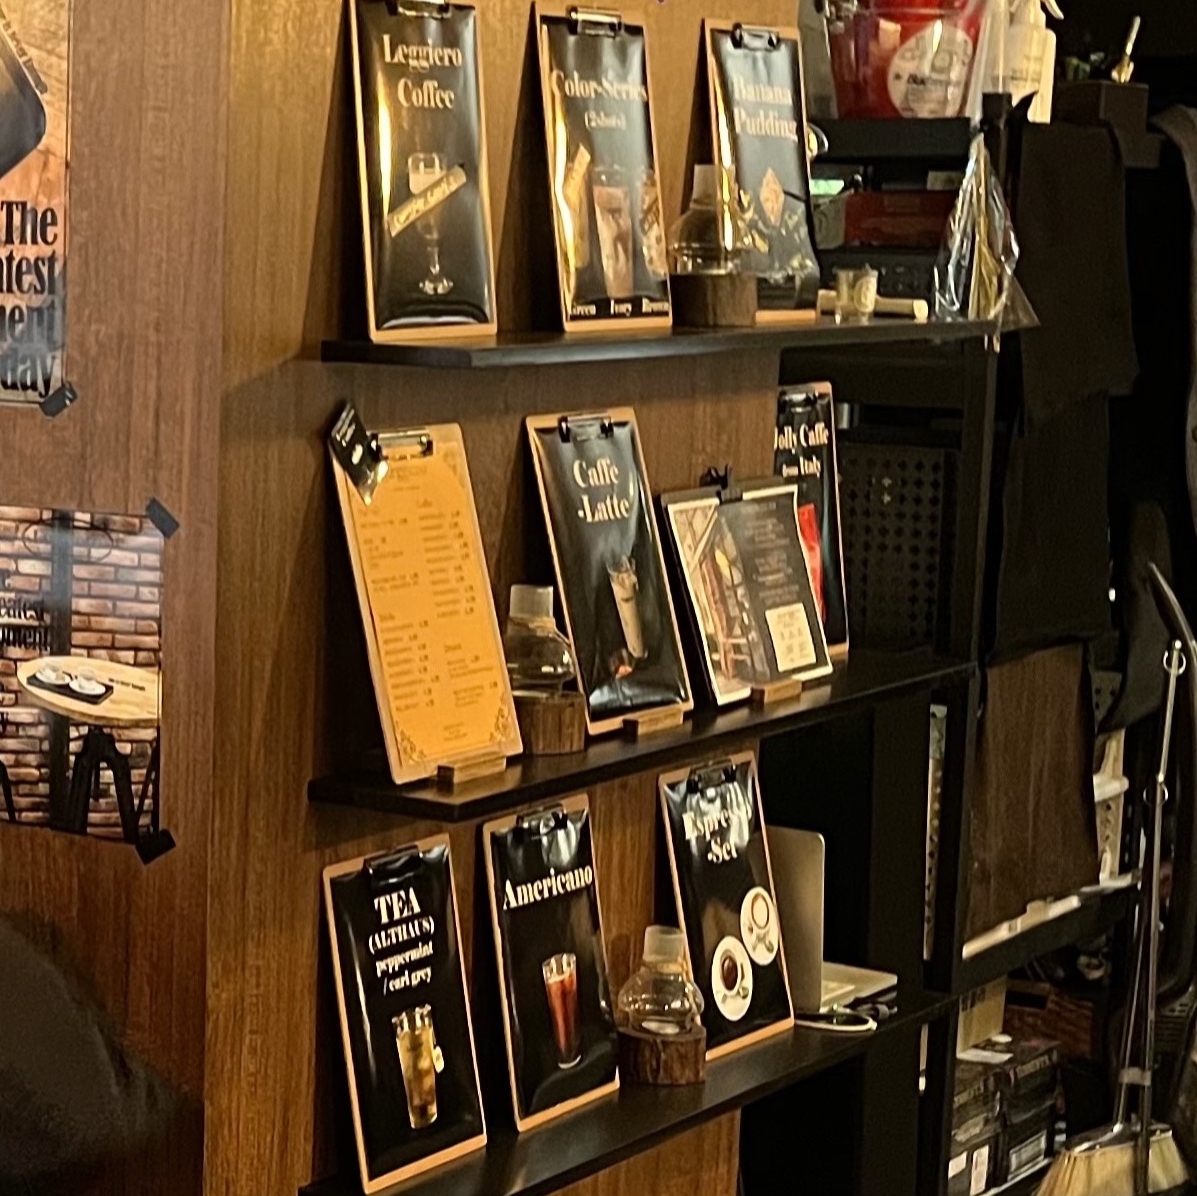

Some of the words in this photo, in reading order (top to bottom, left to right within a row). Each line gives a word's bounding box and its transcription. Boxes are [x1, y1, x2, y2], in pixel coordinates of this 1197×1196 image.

[383, 33, 463, 74] Leggiero
[397, 77, 456, 109] Coffee
[0, 200, 58, 246] The
[0, 347, 57, 399] day
[573, 456, 620, 489] Caffe
[373, 887, 421, 925] TEA
[503, 865, 593, 911] Americano
[368, 915, 435, 955] (ALTHAUS)
[375, 940, 433, 978] peppermint
